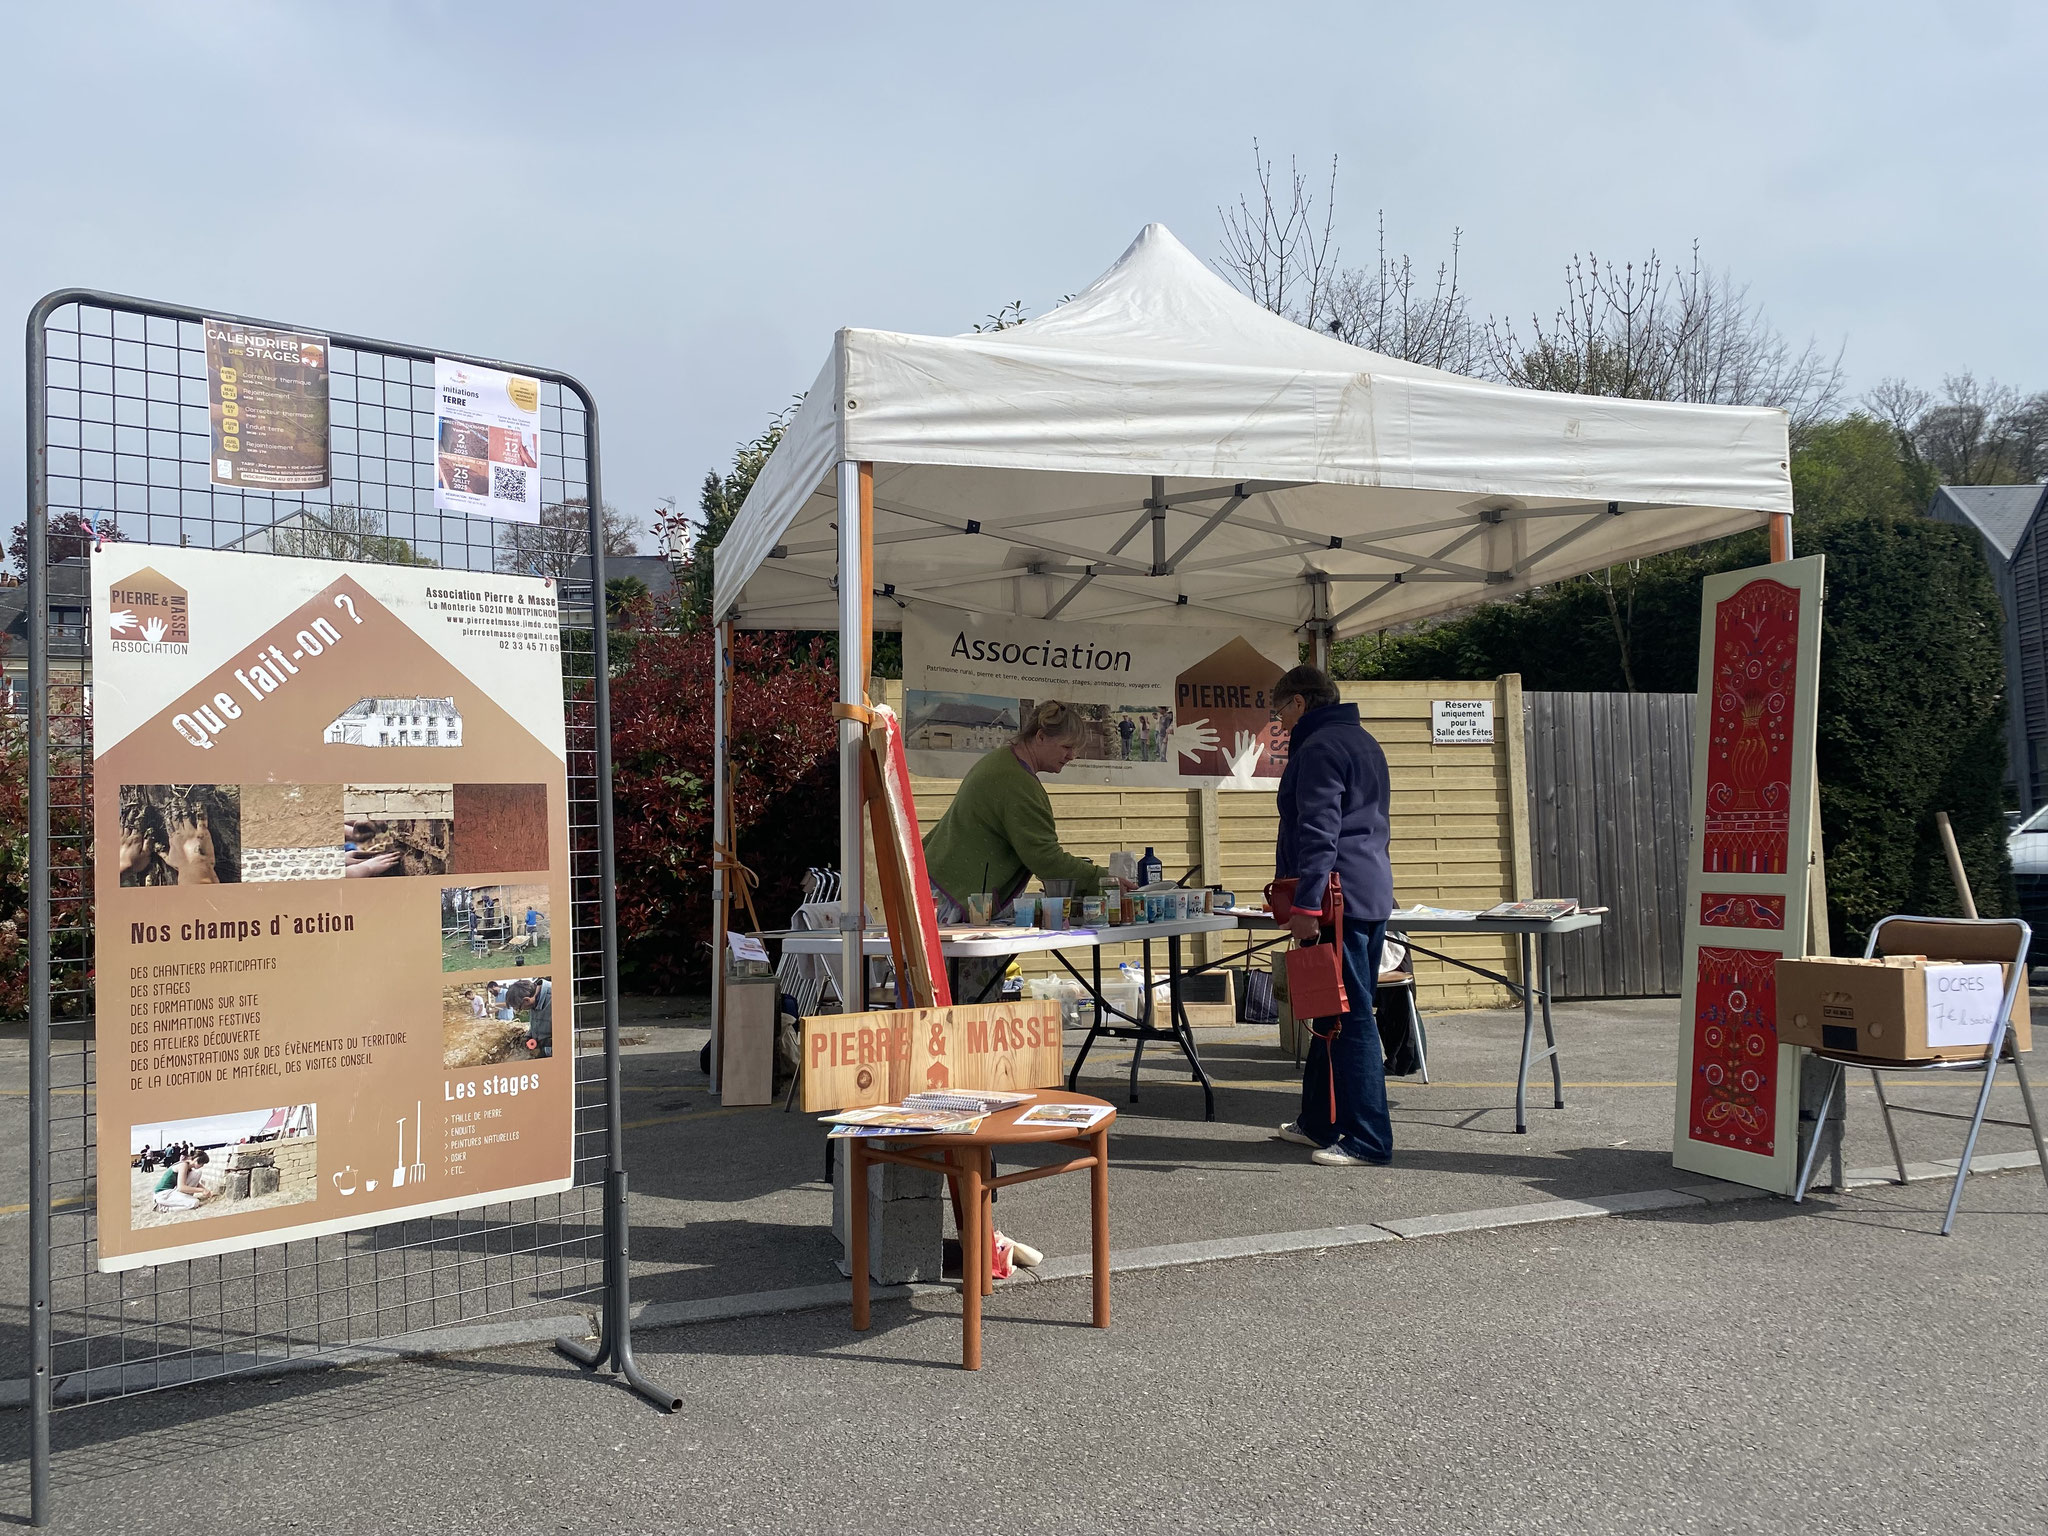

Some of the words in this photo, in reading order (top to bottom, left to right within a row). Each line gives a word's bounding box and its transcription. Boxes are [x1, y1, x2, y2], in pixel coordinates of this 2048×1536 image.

[207, 329, 299, 352] CALENDRIER
[228, 348, 244, 356] DES
[246, 347, 300, 363] STAGES
[242, 372, 277, 382] Correcteur
[280, 377, 312, 386] thermique
[443, 385, 479, 398] initiations
[443, 395, 466, 406] TERRE
[244, 406, 280, 415] Correcteur
[246, 423, 266, 431] Enduit
[458, 434, 465, 444] 2
[505, 442, 518, 452] 12
[453, 468, 468, 479] 25
[112, 590, 160, 606] PIERRE
[162, 597, 168, 606] &
[426, 587, 481, 601] Association
[484, 591, 514, 604] Pierre
[518, 595, 524, 604] &
[528, 595, 556, 606] Masse
[170, 596, 186, 637] MASSE
[428, 601, 438, 610] La
[441, 602, 476, 612] Monterie
[479, 605, 503, 614] 50210
[506, 607, 557, 618] MONTPINCHON
[446, 616, 558, 630] www.pierreetmasse.jimdo.com
[462, 628, 559, 641] pierreetmasse@gmail.com
[112, 641, 188, 655] ASSOCIATION
[500, 641, 509, 649] 02
[512, 642, 523, 650] 33
[526, 642, 536, 651] 45
[539, 643, 547, 651] 71
[550, 644, 559, 652] 69
[951, 631, 1131, 671] Association
[172, 692, 242, 750] Que
[234, 616, 342, 702] fait-on
[334, 593, 364, 625] ?
[926, 665, 959, 673] Patrimoine
[960, 668, 975, 676] rural,
[1021, 676, 1069, 684] écoconstruction,
[1072, 678, 1092, 686] stages,
[1094, 680, 1126, 688] animations,
[1178, 684, 1251, 708] PIERRE
[1256, 691, 1265, 708] &
[1442, 710, 1484, 719] uniquement
[1450, 720, 1467, 728] pour
[131, 922, 171, 944] Nos
[181, 918, 261, 942] champs
[130, 967, 148, 980] DES
[153, 962, 206, 978] CHANTIERS
[210, 957, 277, 974] PARTICIPATIFS
[130, 985, 148, 998] DES
[153, 981, 190, 996] STAGES
[1938, 977, 1984, 992] OCRES
[130, 1004, 148, 1017] DES
[153, 999, 214, 1014] FORMATIONS
[218, 996, 235, 1009] SUR
[239, 994, 259, 1007] SITE
[130, 1022, 148, 1035] DES
[153, 1016, 214, 1033] ANIMATIONS
[219, 1011, 261, 1027] FESTIVES
[130, 1040, 148, 1054] DES
[153, 1035, 199, 1051] ATELIERS
[204, 1030, 260, 1046] DÉCOUVERTE
[811, 1027, 909, 1068] PIERRE
[928, 1023, 946, 1057] &
[967, 1015, 1057, 1055] MASSE
[130, 1059, 148, 1072] DES
[153, 1049, 239, 1070] DÉMONSTRATIONS
[244, 1047, 260, 1060] SUR
[264, 1045, 280, 1058] DES
[285, 1039, 343, 1056] ÉVÈNEMENTS
[347, 1037, 358, 1050] DU
[361, 1032, 407, 1048] TERRITOIRE
[130, 1077, 143, 1091] DE
[148, 1076, 161, 1089] LA
[166, 1069, 212, 1087] LOCATION
[216, 1067, 228, 1081] DE
[233, 1062, 282, 1080] MATÉRIEL,
[286, 1061, 301, 1074] DES
[305, 1057, 337, 1071] VISITES
[340, 1053, 373, 1068] CONSEIL
[444, 1080, 476, 1101] Les
[483, 1073, 539, 1096] stages
[450, 1113, 472, 1124] TAILLE
[474, 1111, 481, 1120] DE
[484, 1108, 502, 1119] PIERRE
[450, 1125, 476, 1136] ENDUITS
[450, 1137, 482, 1150] PEINTURES
[484, 1131, 520, 1145] NATURELLES
[450, 1152, 467, 1162] OSIER
